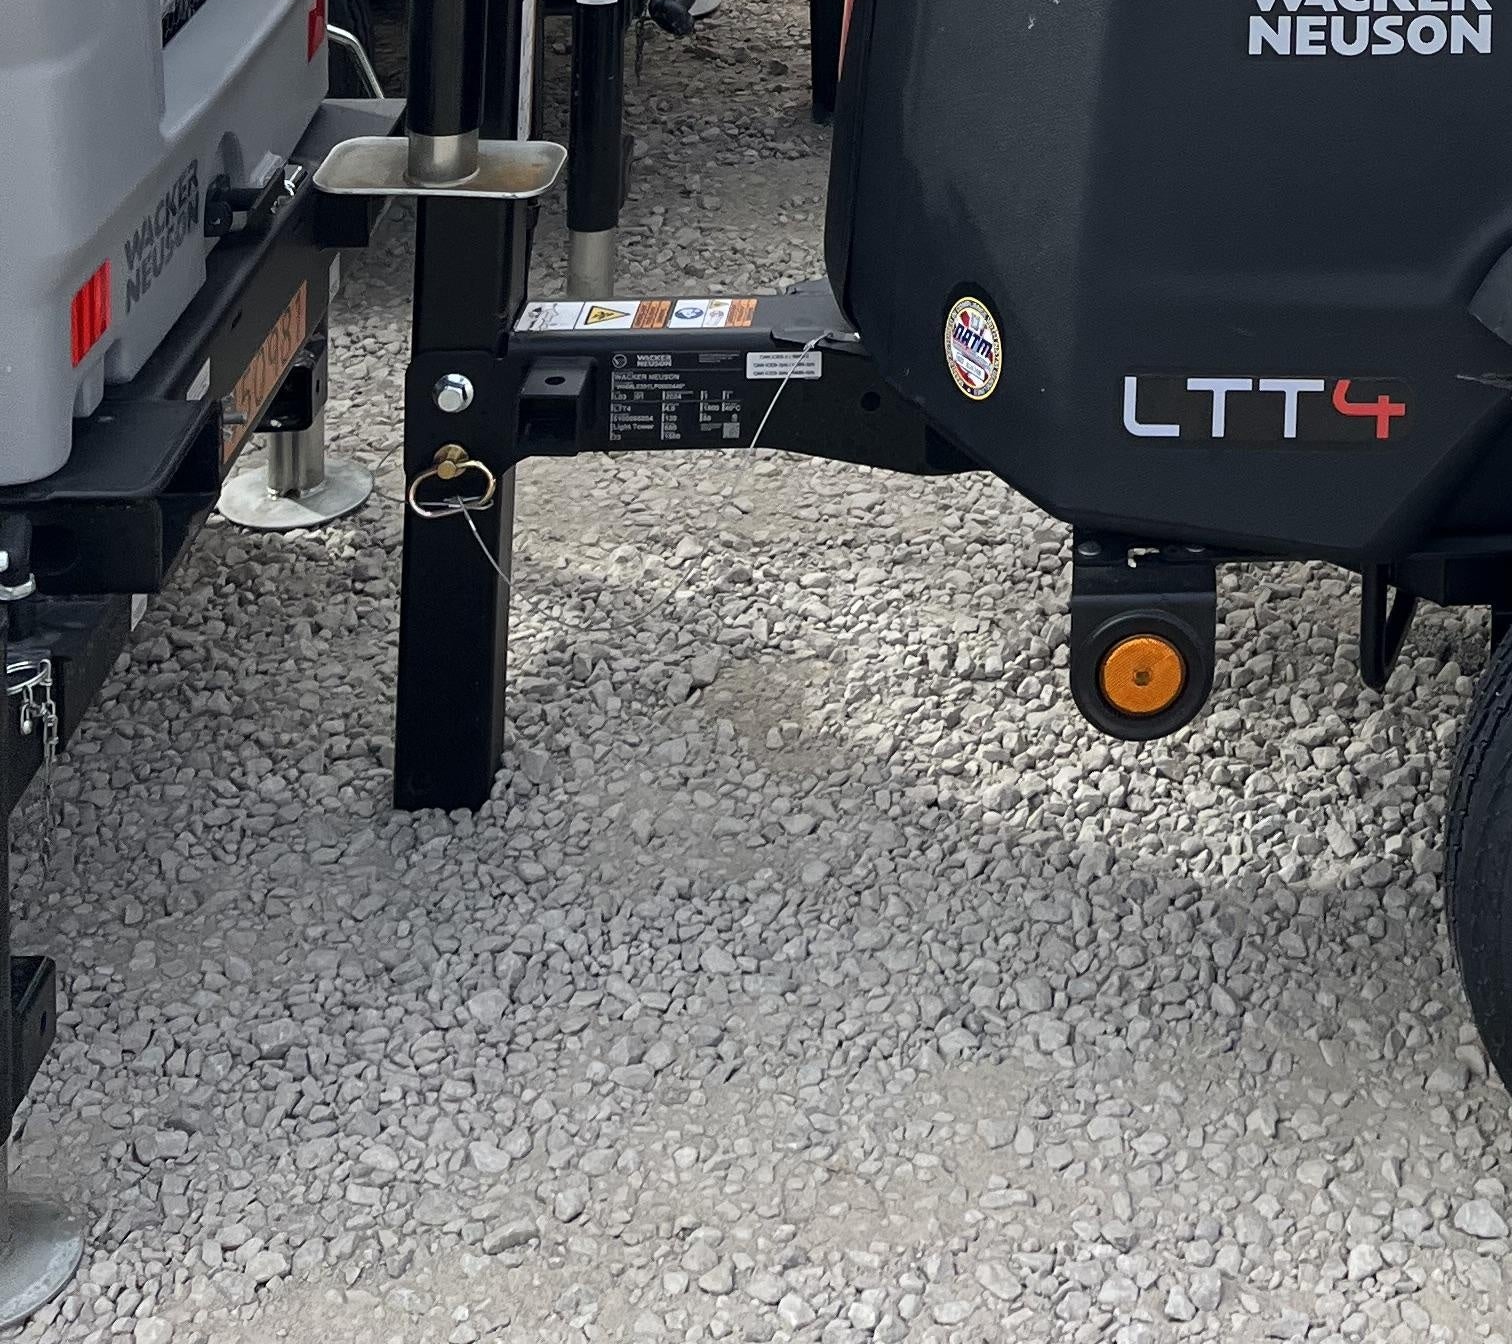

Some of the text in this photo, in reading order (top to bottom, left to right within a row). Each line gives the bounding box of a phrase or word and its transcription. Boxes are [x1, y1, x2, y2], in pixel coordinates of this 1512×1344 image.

[1248, 15, 1493, 56] NEUSON
[124, 159, 199, 271] WACKER
[126, 189, 199, 315] NEUSON
[1124, 376, 1406, 439] LTT4
